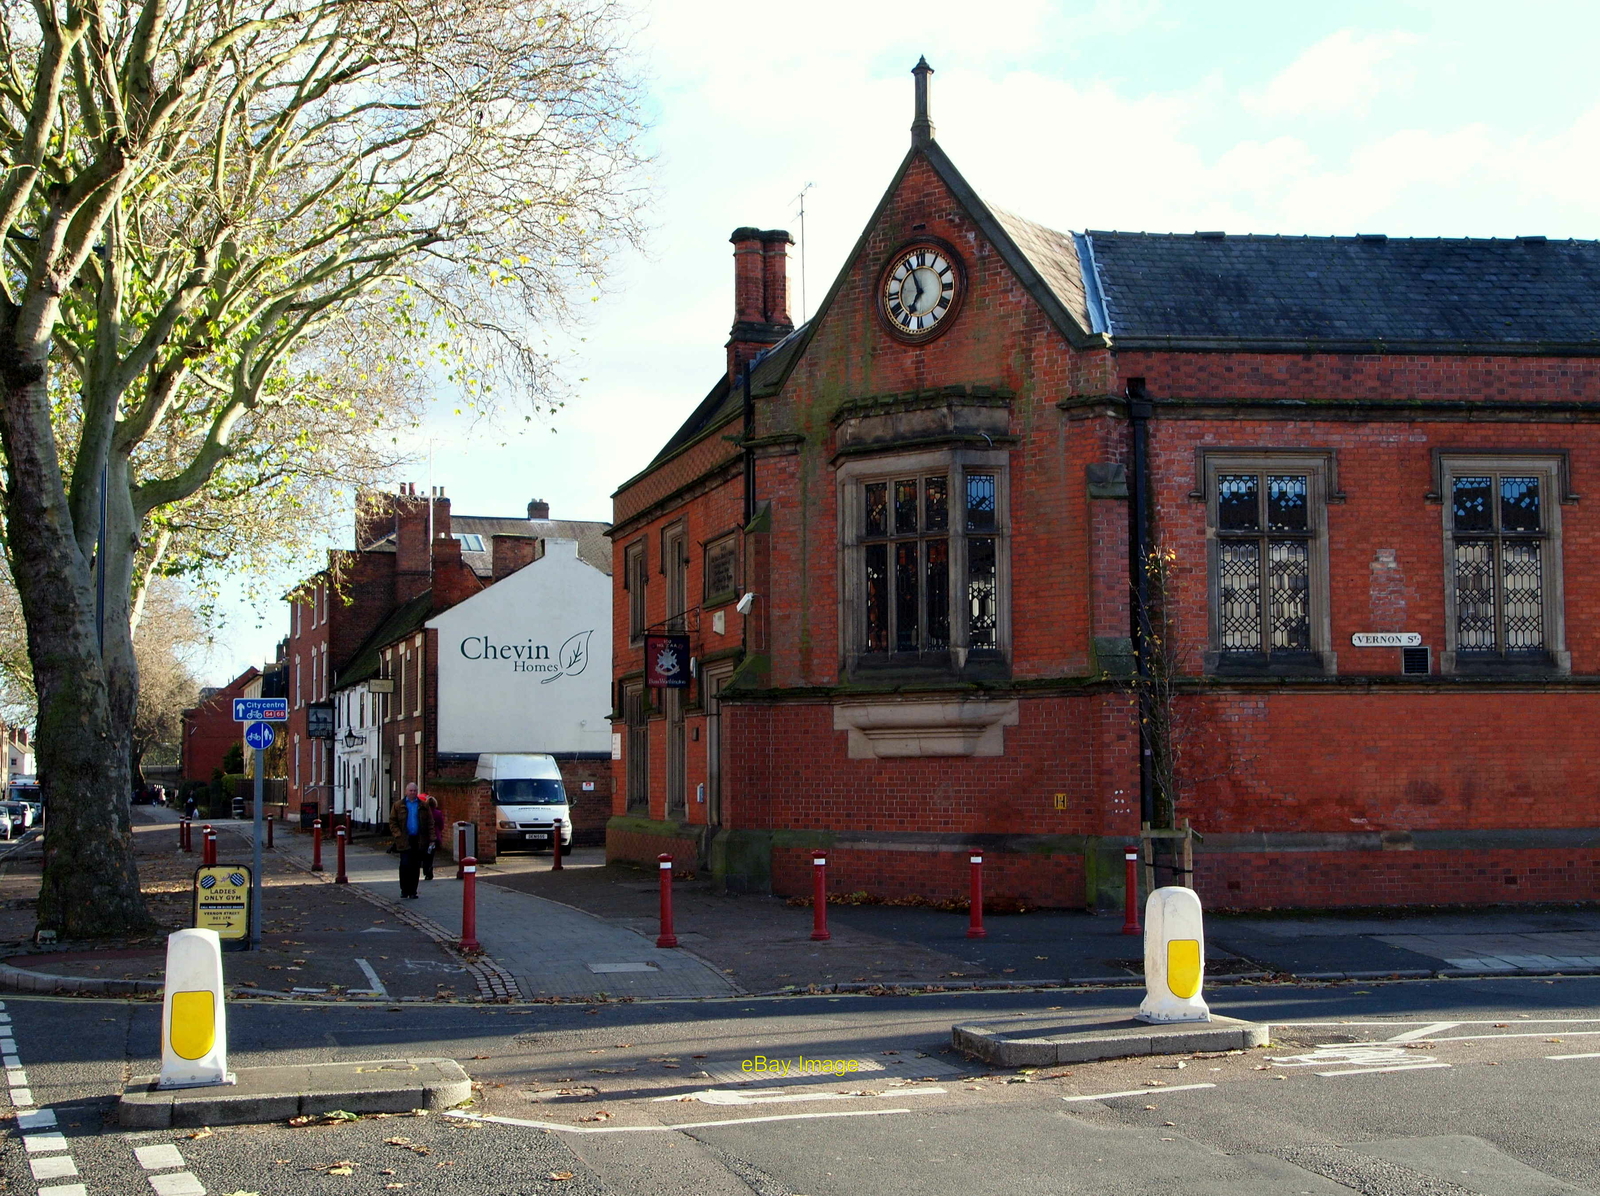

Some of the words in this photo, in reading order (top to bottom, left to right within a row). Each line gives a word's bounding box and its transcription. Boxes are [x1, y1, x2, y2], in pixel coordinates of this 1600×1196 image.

[1357, 635, 1402, 644] VERNON
[460, 636, 550, 660] Chevin
[513, 661, 559, 672] Homes
